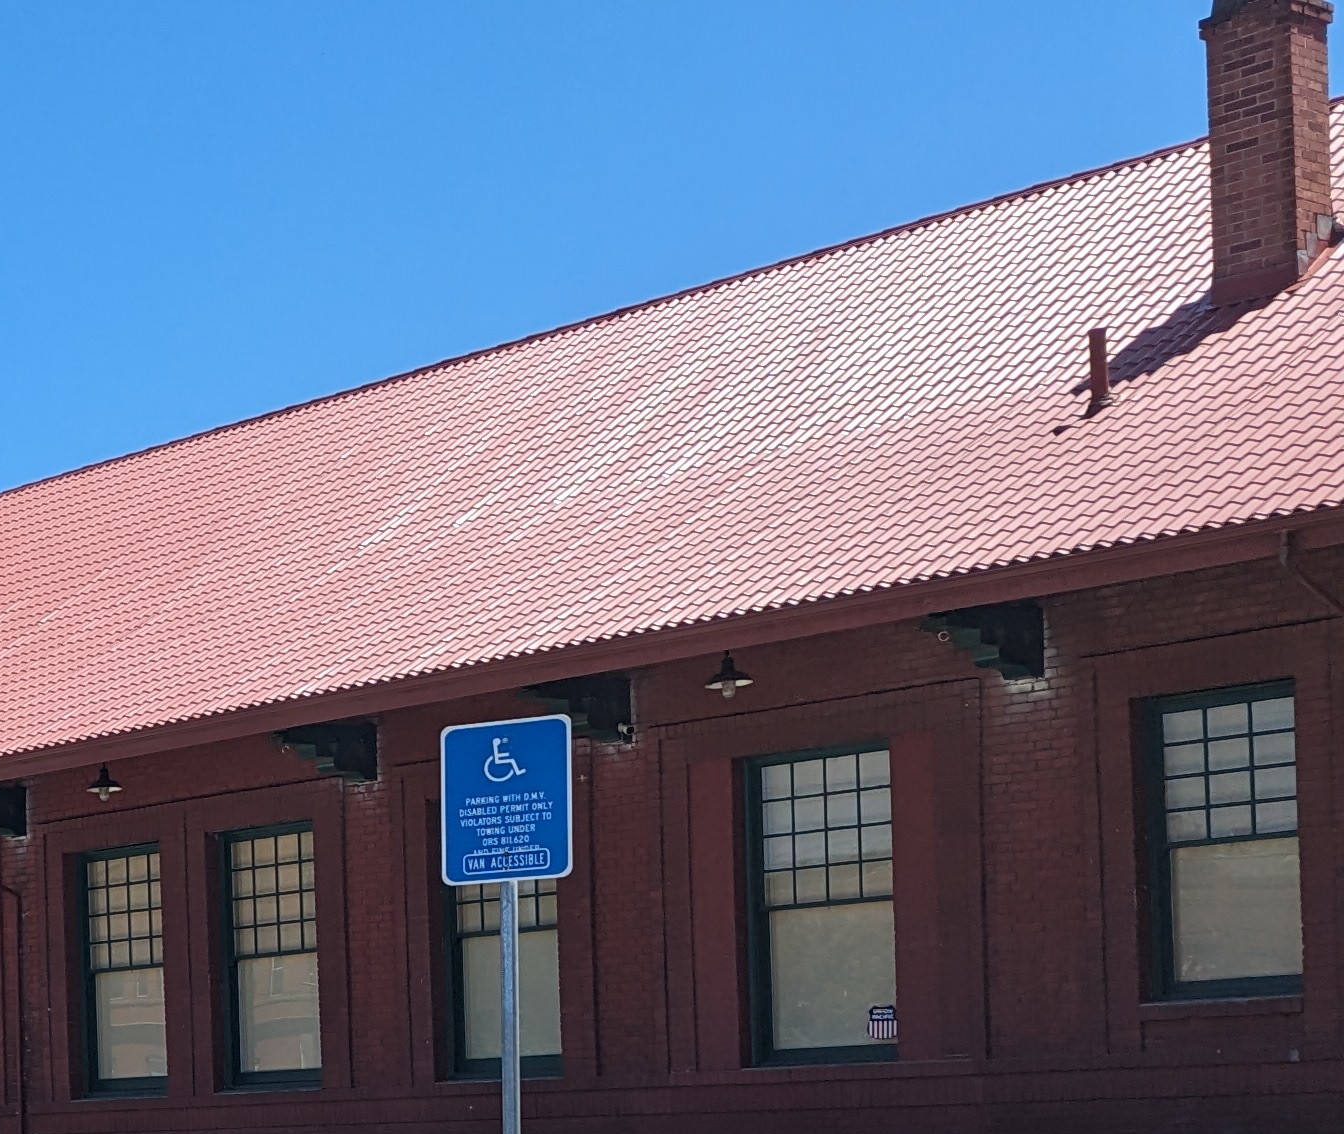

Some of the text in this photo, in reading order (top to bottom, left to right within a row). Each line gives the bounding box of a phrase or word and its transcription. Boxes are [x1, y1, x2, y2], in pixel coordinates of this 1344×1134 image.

[466, 796, 499, 806] PARKING
[502, 794, 521, 802] WITH
[459, 801, 553, 817] DISABLED PERMIT ONLY
[460, 812, 551, 827] VIOLATORS SUBJECT TO
[476, 824, 535, 836] TOWING UNDER
[483, 837, 498, 846] ORS
[468, 853, 544, 870] VAN ACCESSIBLE
